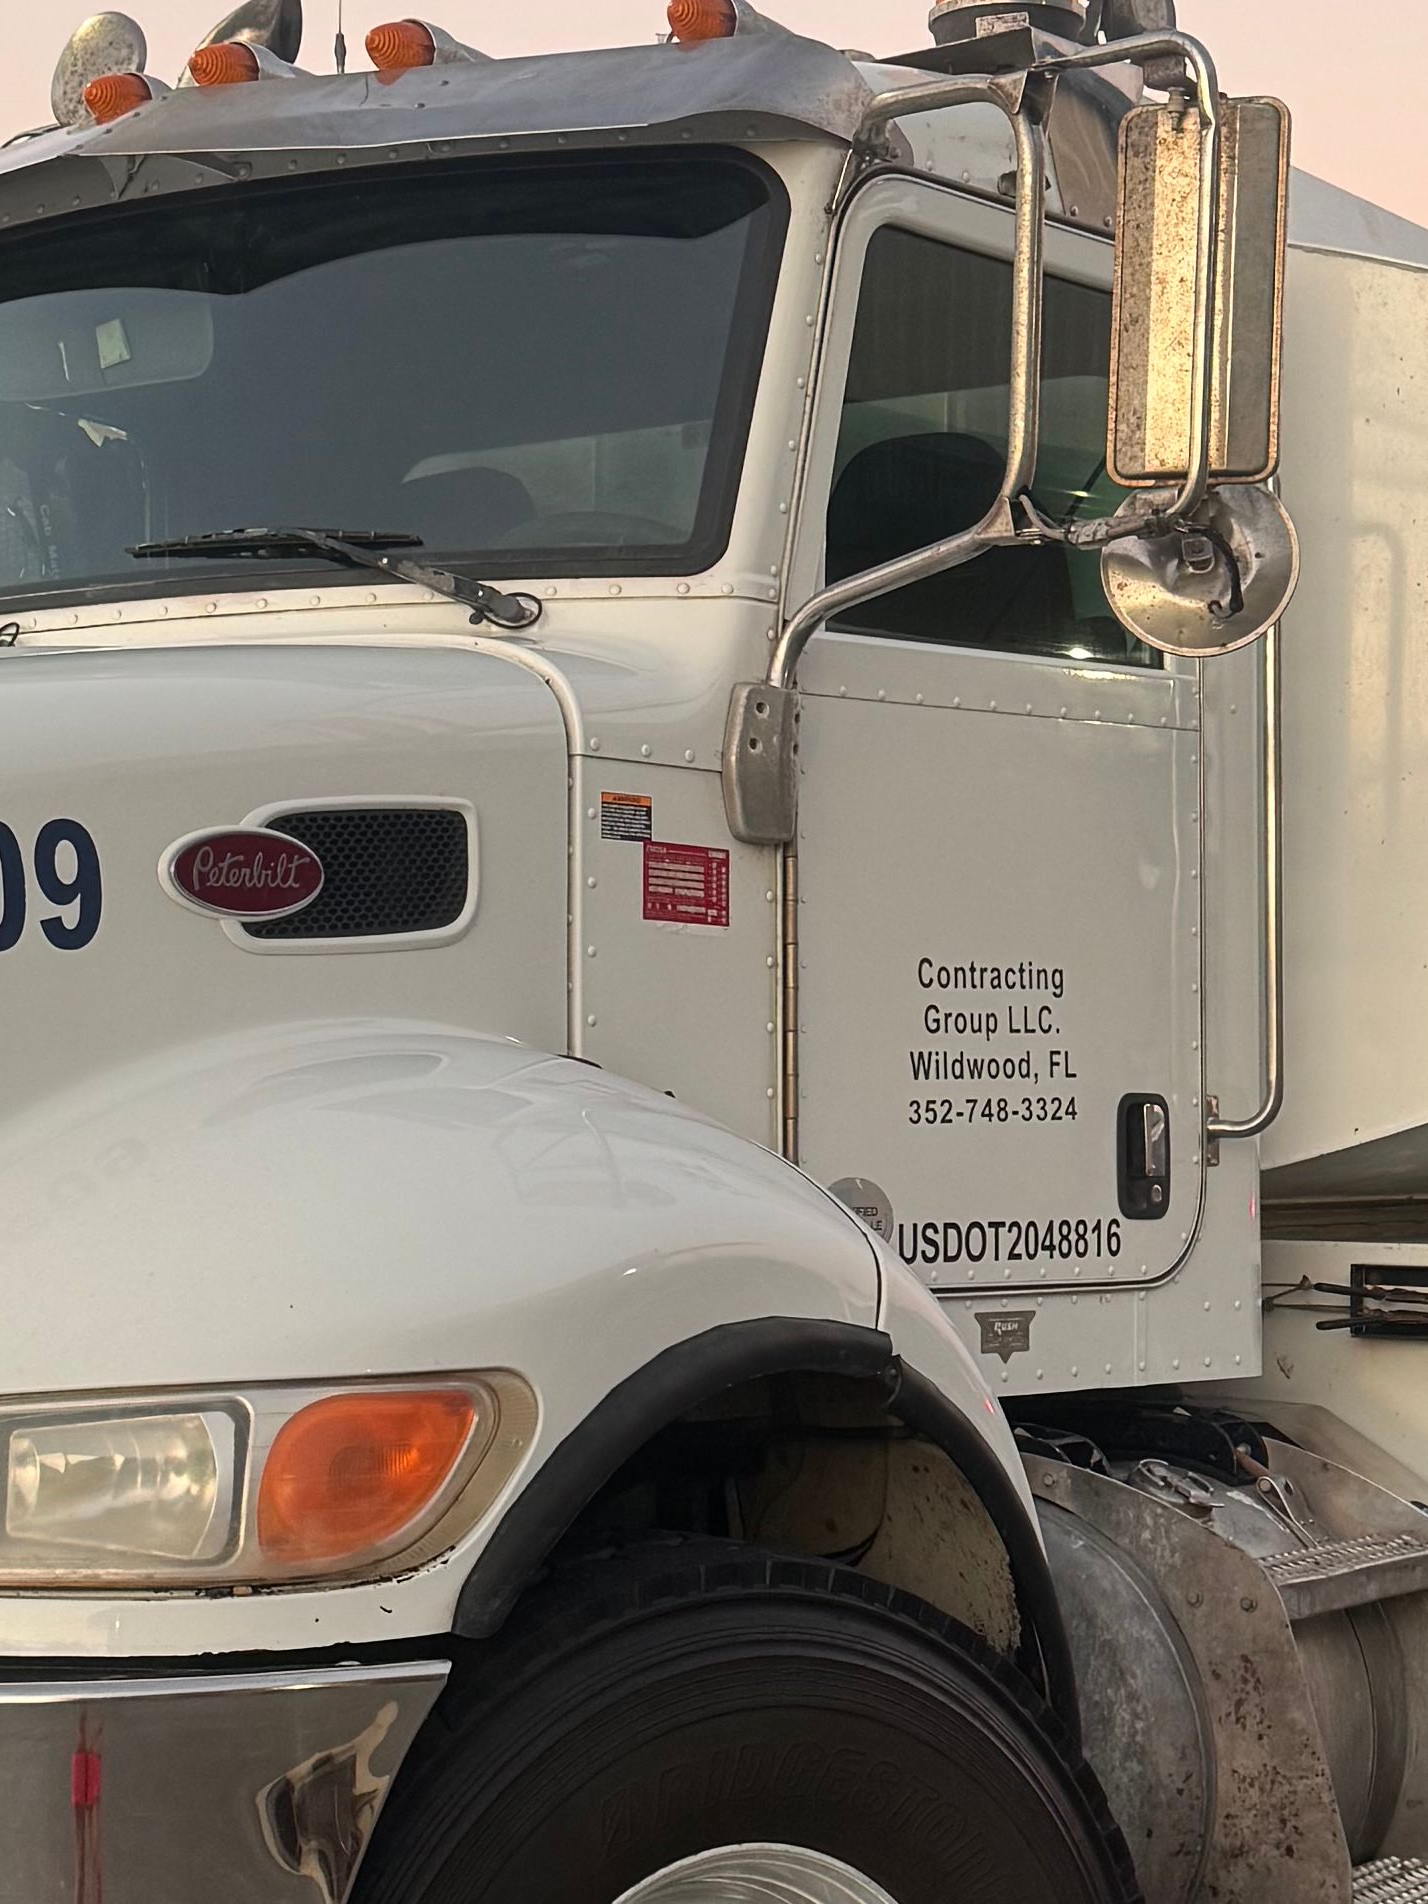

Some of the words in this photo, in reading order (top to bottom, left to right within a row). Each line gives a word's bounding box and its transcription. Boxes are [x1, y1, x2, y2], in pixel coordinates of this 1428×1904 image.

[192, 846, 311, 891] Peterbilt
[918, 957, 1064, 998] Contracting
[924, 1004, 998, 1041] Group
[1008, 1005, 1060, 1034] LLC.
[910, 1050, 1039, 1084] Wildwood,
[1049, 1050, 1077, 1078] FL
[909, 1097, 1078, 1124] 352-748-3324
[898, 1218, 1121, 1265] USDOT2048816
